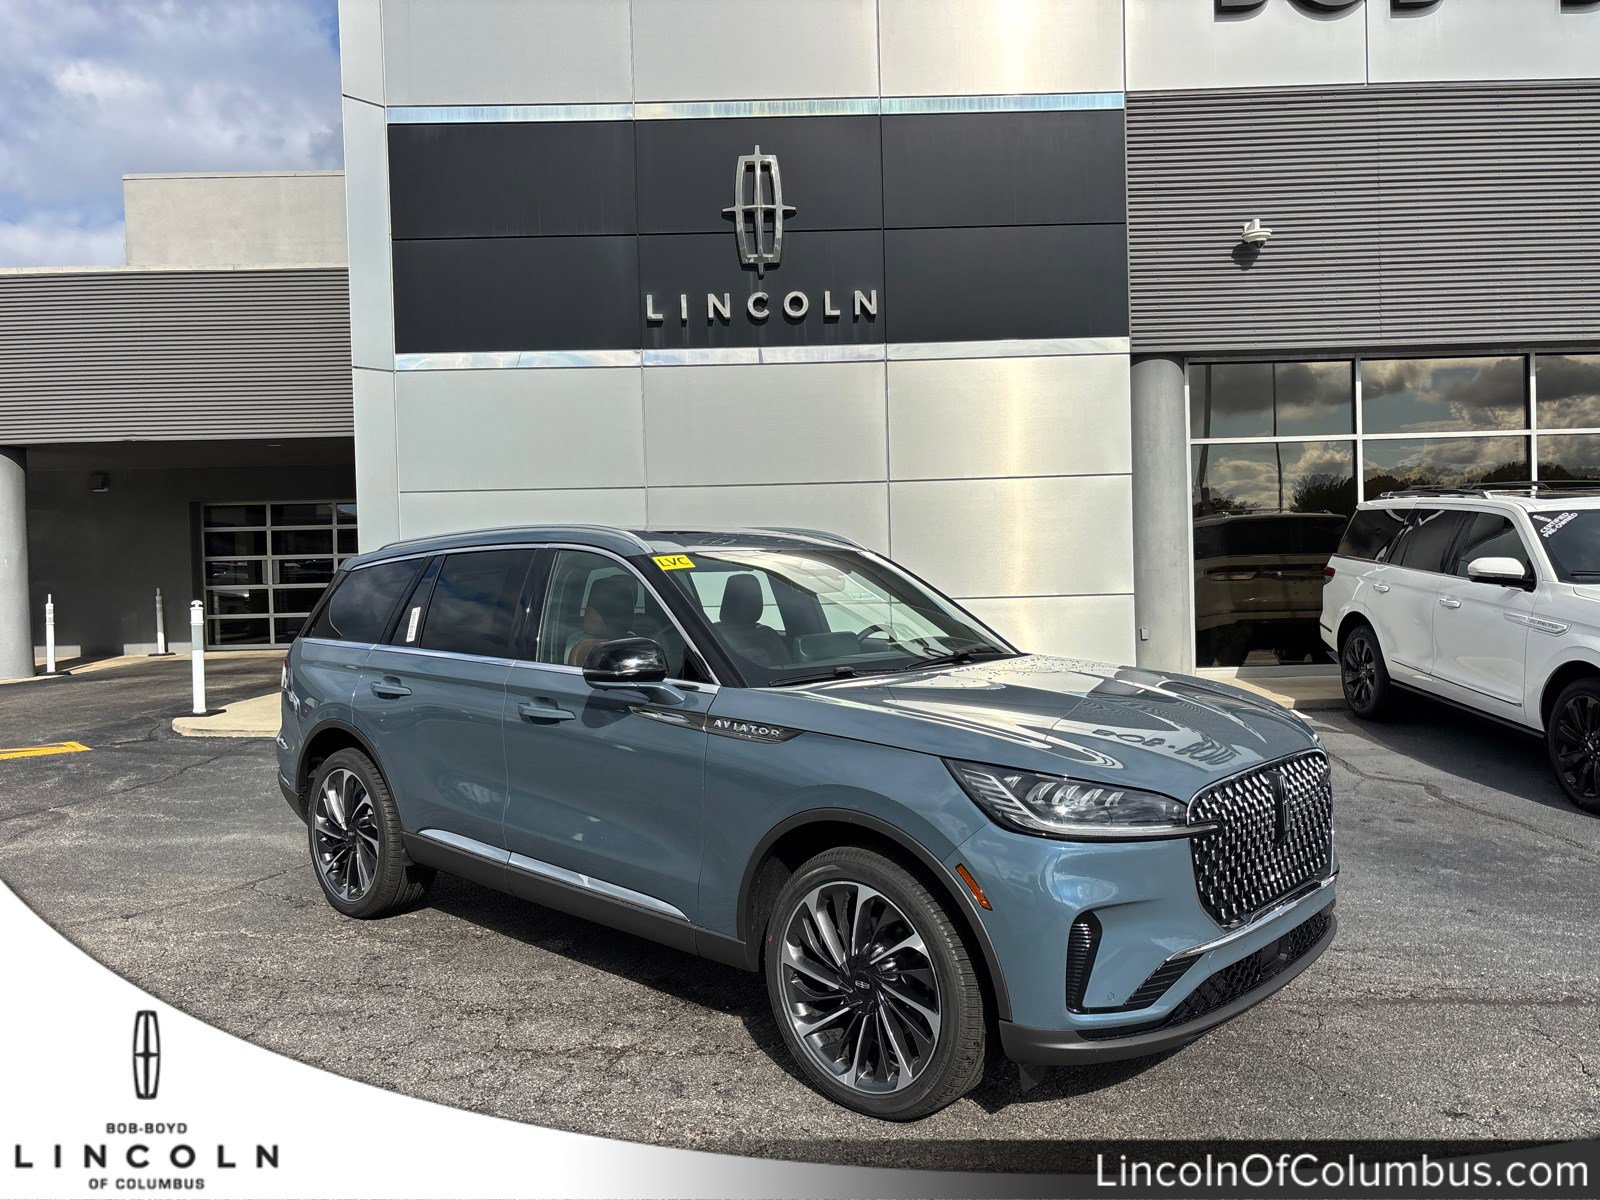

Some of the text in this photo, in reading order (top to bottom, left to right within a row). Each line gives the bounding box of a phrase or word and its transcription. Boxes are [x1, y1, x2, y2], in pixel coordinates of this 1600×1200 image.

[646, 290, 877, 321] LINCOLN
[1540, 512, 1569, 533] CERTIFIED
[657, 556, 691, 567] LVC
[713, 719, 781, 737] AVIATOR
